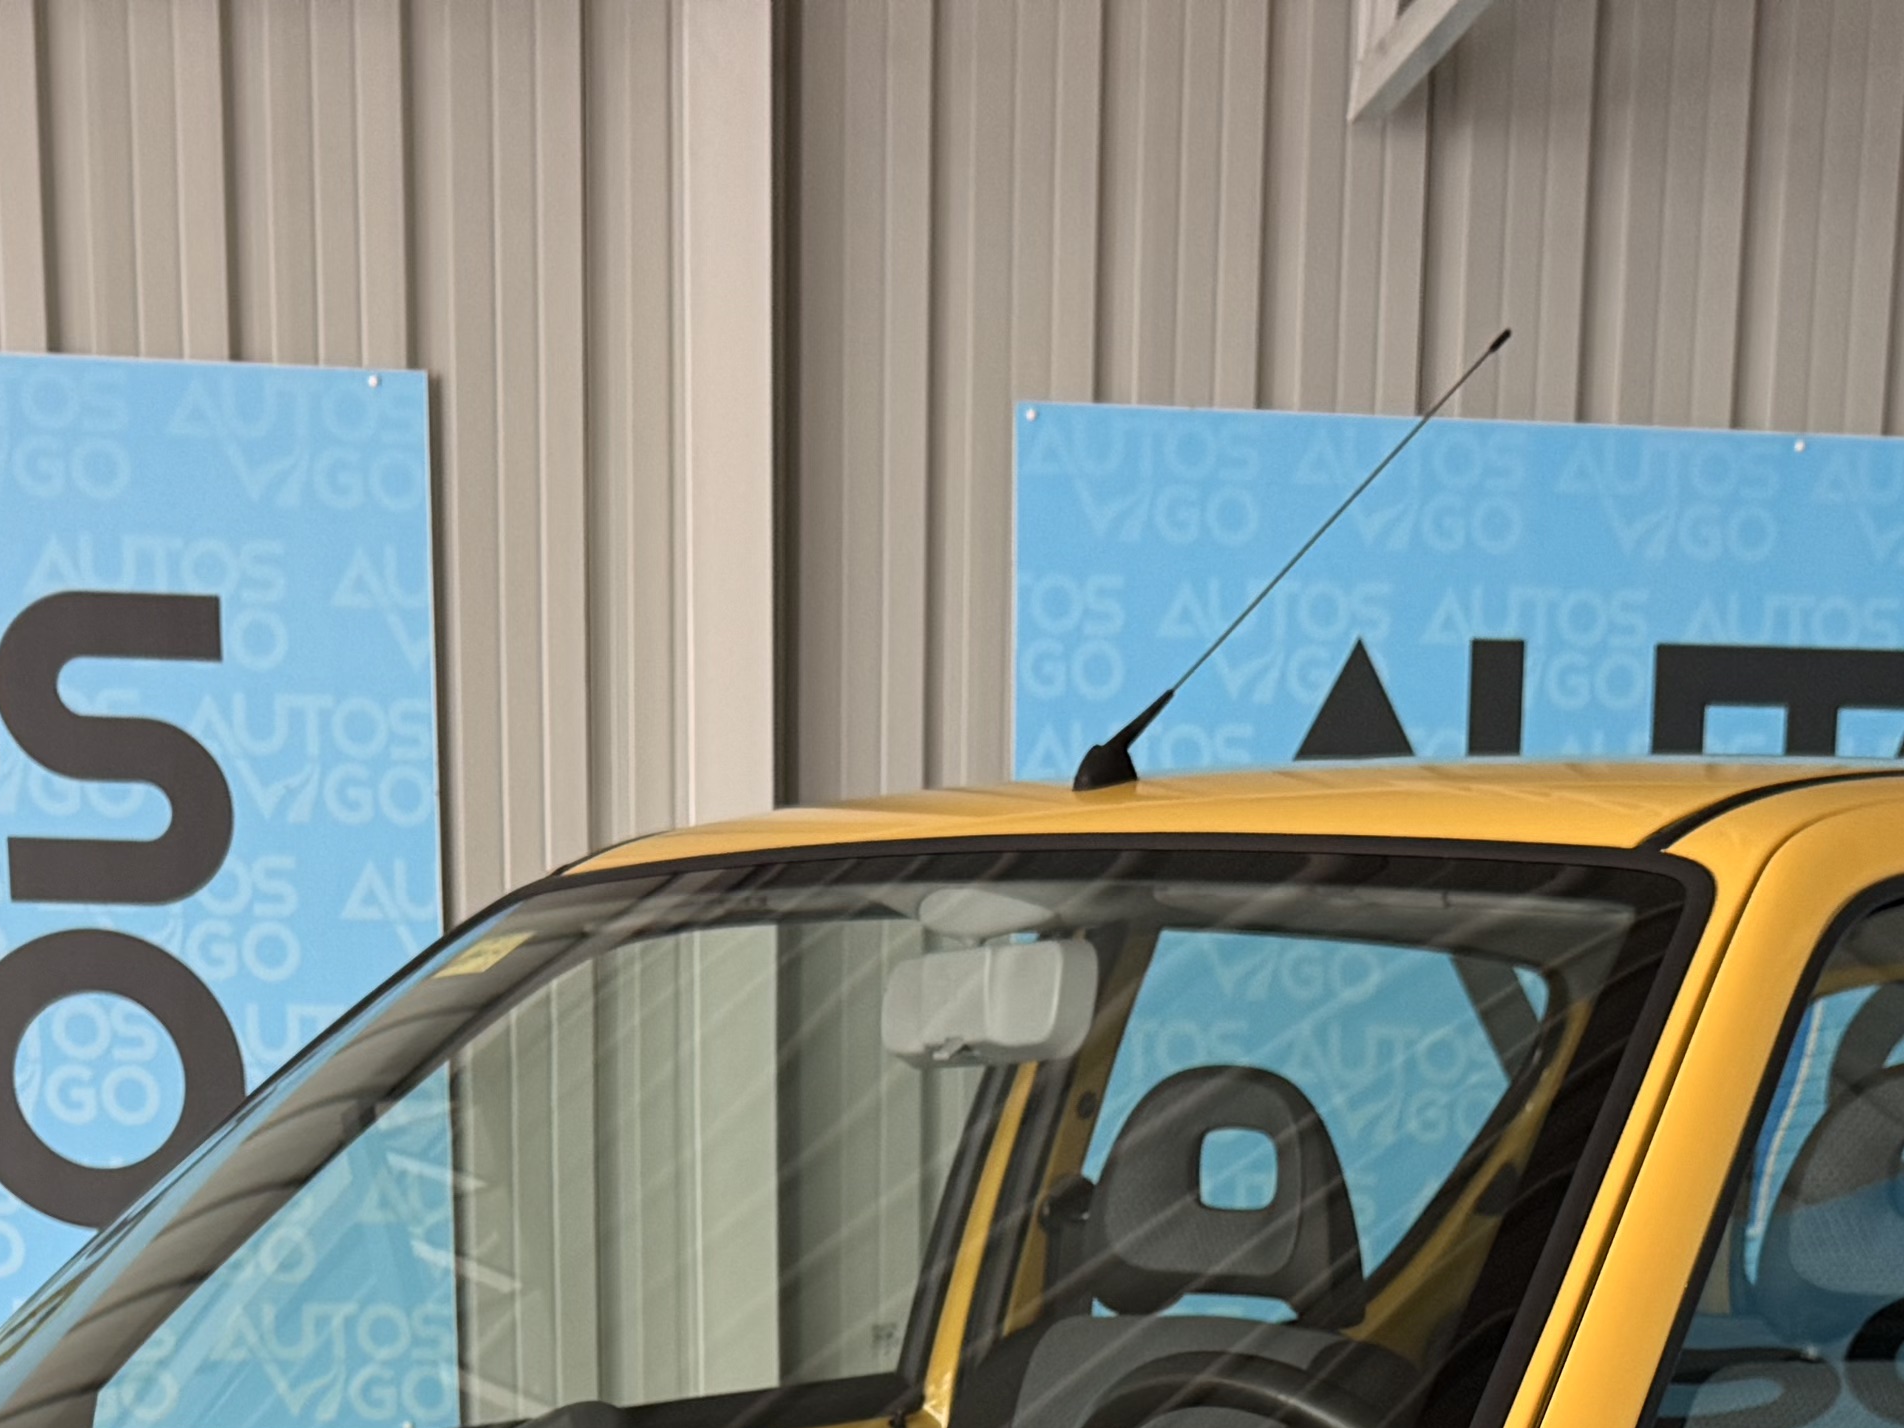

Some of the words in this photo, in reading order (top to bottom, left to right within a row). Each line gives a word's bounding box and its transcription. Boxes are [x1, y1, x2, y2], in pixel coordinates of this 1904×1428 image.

[164, 371, 425, 443] AUTOS
[25, 533, 287, 603] AUTOS
[179, 690, 436, 756] AUTOS
